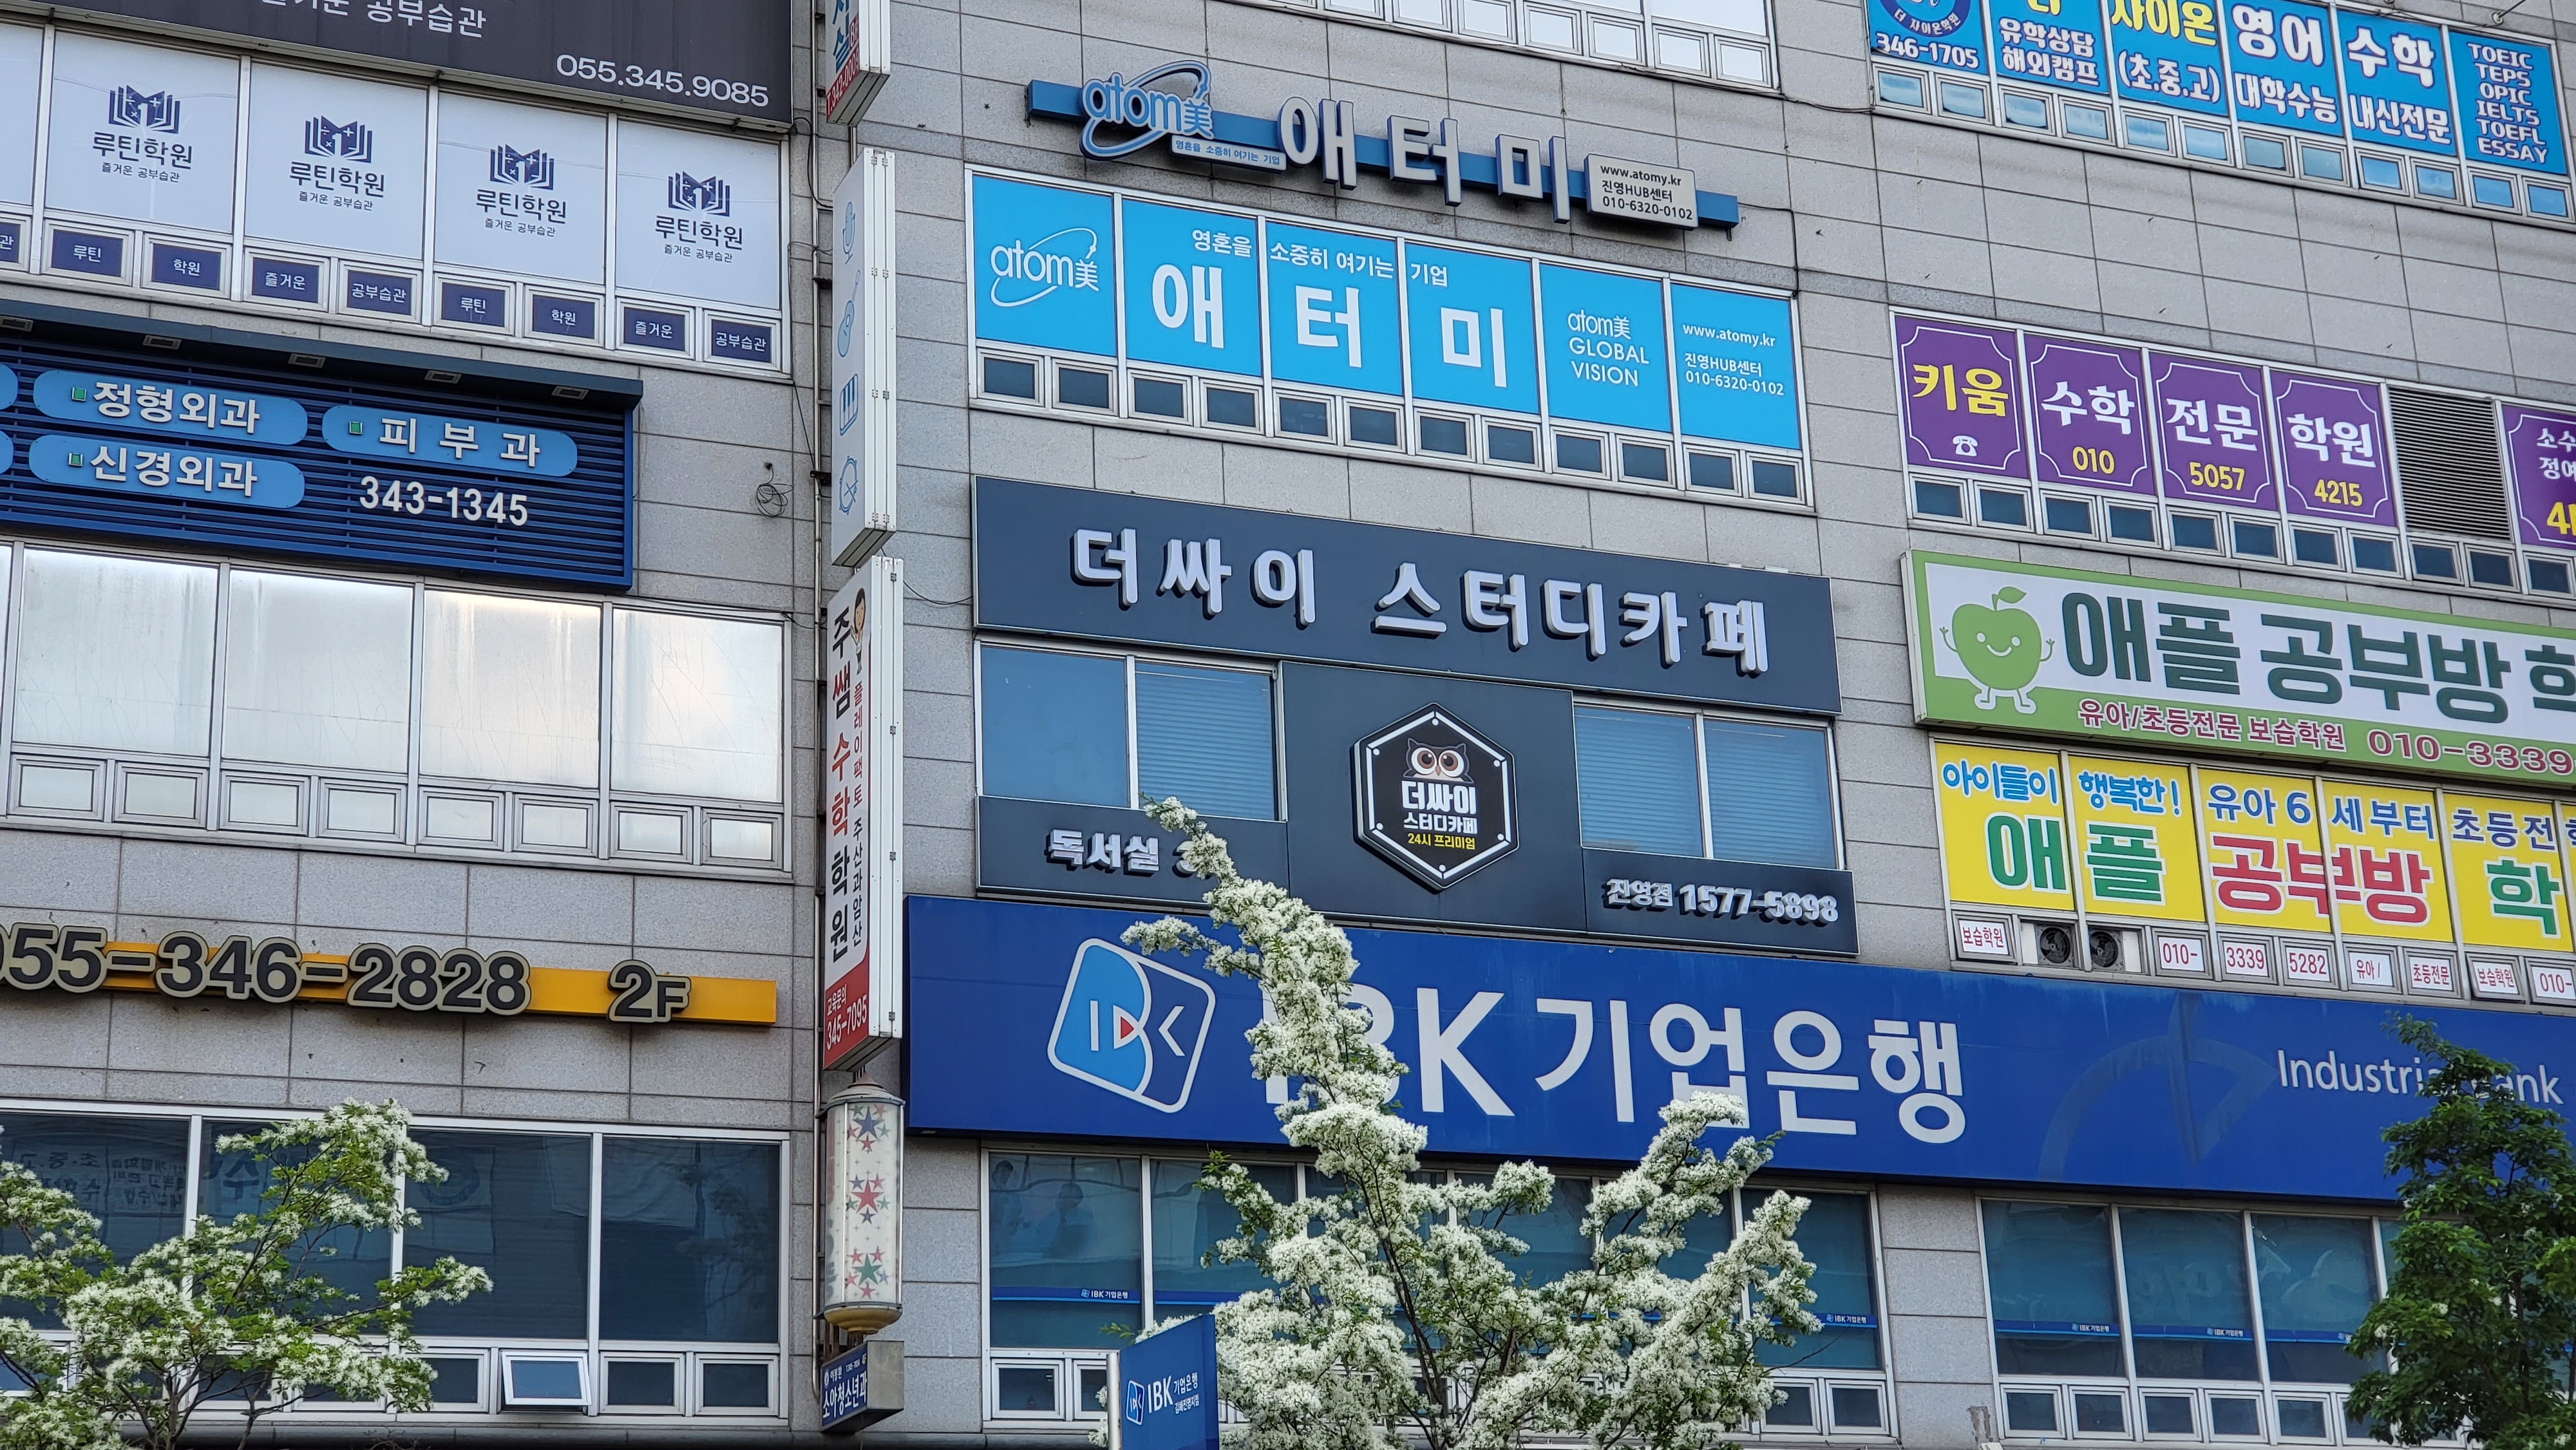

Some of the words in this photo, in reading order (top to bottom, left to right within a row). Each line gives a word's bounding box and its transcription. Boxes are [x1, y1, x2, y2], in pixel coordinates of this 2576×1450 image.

[1876, 32, 1979, 69] 346-1705
[1999, 17, 2096, 59] 유학상담
[2231, 5, 2324, 67] 영어
[2347, 27, 2435, 88] 수학
[2467, 42, 2533, 70] TOEIC
[556, 53, 769, 107] 055.345.9085
[2000, 45, 2099, 86] 해외캠프
[2117, 50, 2221, 103] (초.중.고)
[2475, 62, 2531, 88] TEPS
[2235, 72, 2338, 124] 대학수능
[2349, 94, 2451, 145] 내신전문
[2477, 100, 2541, 126] IELTS
[2479, 81, 2532, 107] OPIC
[92, 131, 192, 170] 루틴학원
[2476, 118, 2546, 146] TOEFL
[2478, 137, 2548, 164] ESSAY
[102, 161, 133, 177] 즐거운
[138, 167, 180, 183] 공부습관
[1175, 139, 1201, 155] 영혼을
[1206, 143, 1231, 158] 소중히
[1234, 147, 1259, 162] 여기는
[1263, 154, 1280, 166] 기업
[289, 161, 384, 197] 루틴학원
[1601, 164, 1681, 187] www.atomy.kr
[1602, 180, 1673, 203] 진영HUB센터
[299, 191, 328, 205] 즐거운
[333, 196, 373, 211] 공부습관
[476, 188, 566, 225] 루틴학원
[1602, 196, 1693, 220] 010-6320-0102
[484, 218, 513, 232] 즐거운
[517, 221, 556, 237] 공부습관
[655, 215, 743, 251] 루틴학원
[664, 243, 691, 258] 즐거운
[696, 248, 733, 263] 공부습관
[1192, 229, 1252, 258] 영혼을
[1270, 242, 1329, 270] 소중히
[1336, 252, 1394, 279] 여기는
[1410, 263, 1448, 287] 기업
[73, 244, 102, 264] 루틴
[173, 258, 200, 277] 학원
[265, 270, 306, 292] 즐거운
[351, 283, 407, 304] 공부습관
[460, 296, 486, 315] 루틴
[551, 308, 576, 326] 학원
[634, 320, 673, 340] 즐거운
[715, 332, 767, 352] 공부습관
[1568, 337, 1650, 365] GLOBAL
[1682, 322, 1776, 349] www.atomy.kr
[1571, 360, 1639, 388] VISION
[1684, 352, 1762, 377] 진영HUB센터
[1685, 371, 1785, 397] 010-6320-0102
[93, 382, 260, 434] 정형외과
[1913, 364, 2009, 417] 키움
[2040, 381, 2136, 435] 수학
[2166, 397, 2259, 451] 전문
[2286, 413, 2376, 468] 학원
[90, 446, 258, 497] 신경외과
[2072, 446, 2115, 475] 010
[2189, 462, 2246, 491] 5057
[2315, 479, 2363, 507] 4215
[359, 475, 528, 527] 343-1345
[1072, 528, 1316, 626] 더싸이
[1372, 562, 1768, 675] 스터디카페
[2061, 592, 2240, 695] 애플
[2260, 614, 2511, 724] 공부방
[2078, 699, 2241, 742] 유아/초등전문
[2248, 717, 2346, 753] 보습학원
[1401, 780, 1477, 814] 더싸이
[1942, 759, 2056, 805] 아이들이
[2079, 771, 2181, 816] 행복한!
[1403, 812, 1478, 834] 스터디카페
[2208, 785, 2277, 825] 유아
[2286, 792, 2311, 825] 6
[2332, 796, 2435, 840] 세부터
[2452, 809, 2555, 851] 초등전
[1048, 829, 1159, 873] 독서실
[1408, 833, 1431, 847] 24시
[1434, 834, 1475, 850] 프리미엄
[1606, 878, 1674, 908] 진영점
[1679, 883, 1839, 923] 1577-5898
[2486, 860, 2559, 935] 학
[0, 922, 531, 1016] 55-346-2828
[608, 959, 691, 1022] 2F
[1963, 927, 2003, 948] 보습학원
[2163, 943, 2198, 964] 010-
[2226, 947, 2264, 970] 3339
[2289, 952, 2326, 975] 5282
[2413, 963, 2450, 985] 초등전문
[2477, 968, 2514, 988] 보습학원
[2540, 972, 2572, 993] 010-
[827, 984, 847, 1016] 교육문의
[827, 994, 867, 1050] 345-7095
[2278, 1050, 2452, 1097] Industri
[822, 1370, 867, 1418] 소아청소년과
[1148, 1375, 1173, 1413] IBK
[1173, 1371, 1198, 1395] 기업은행
